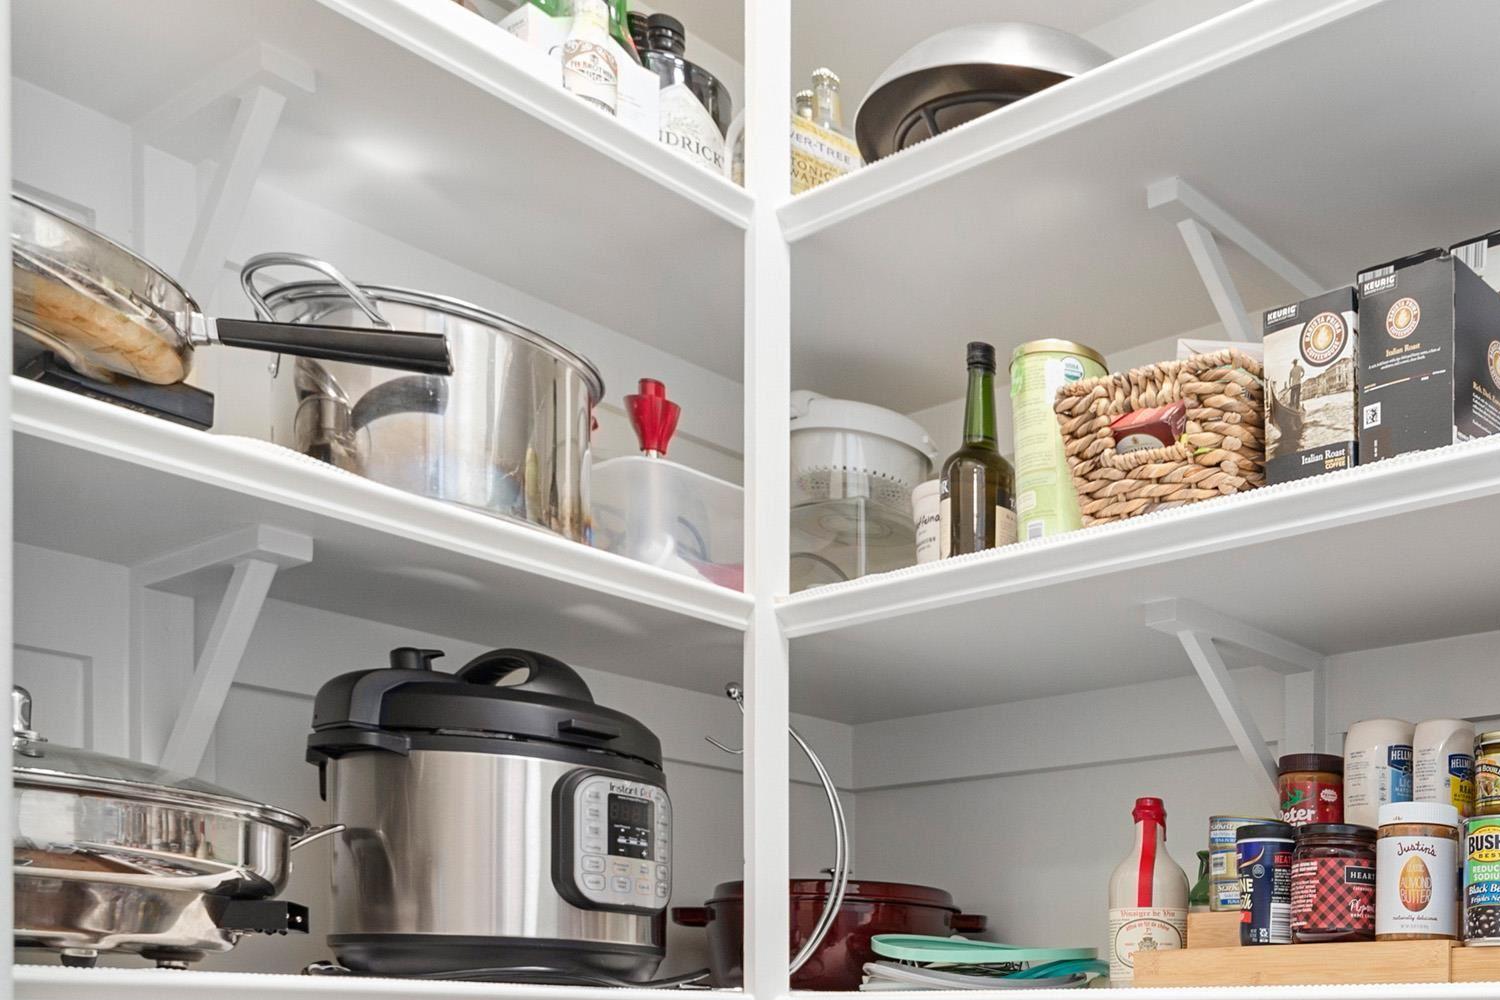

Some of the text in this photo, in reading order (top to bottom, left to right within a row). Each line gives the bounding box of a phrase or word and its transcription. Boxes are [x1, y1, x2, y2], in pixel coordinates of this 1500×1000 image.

[1363, 275, 1397, 292] KEURIG
[1266, 305, 1298, 321] KEURIG
[1385, 348, 1405, 358] Italian
[1405, 342, 1421, 353] Roast
[1301, 447, 1346, 466] Italian Roast
[1324, 460, 1346, 471] COFFEE
[608, 781, 638, 796] Instant
[1397, 841, 1437, 857] Justin's
[1399, 877, 1433, 890] ALMOND
[1468, 884, 1491, 898] Black
[1400, 889, 1433, 904] BUTTER
